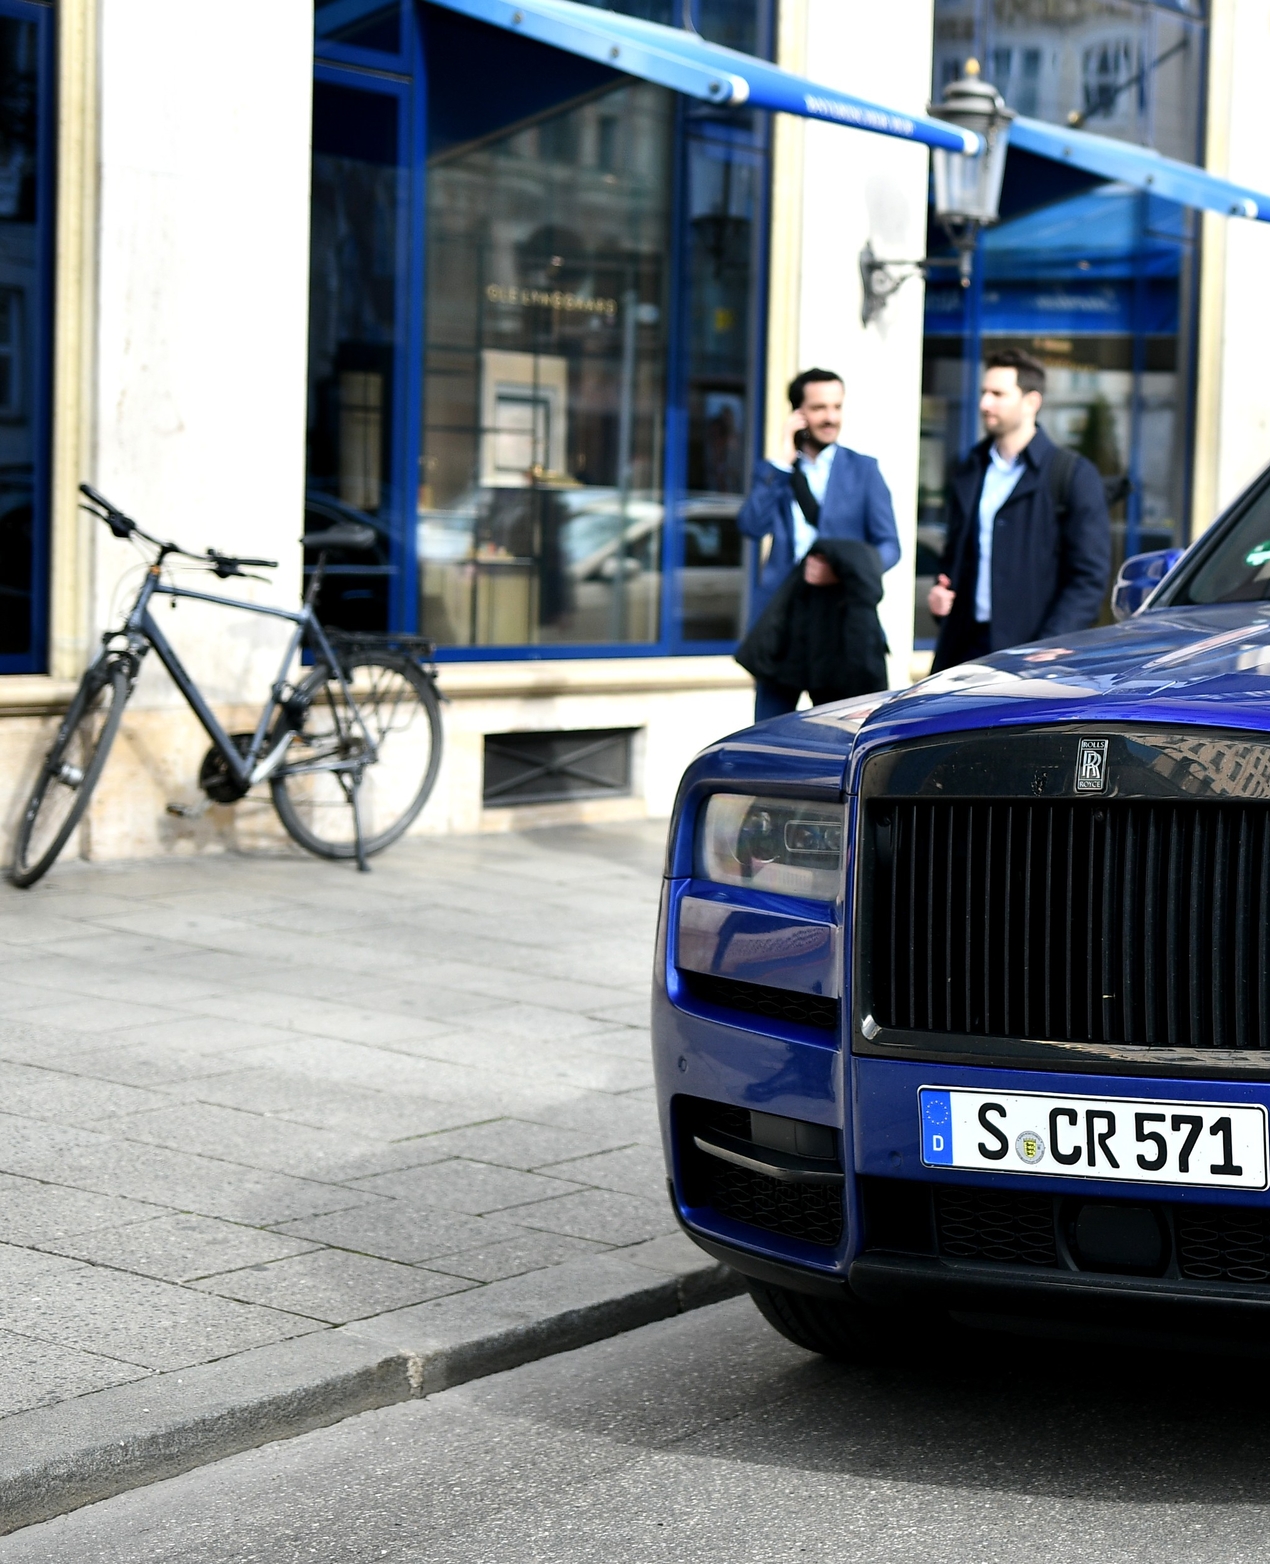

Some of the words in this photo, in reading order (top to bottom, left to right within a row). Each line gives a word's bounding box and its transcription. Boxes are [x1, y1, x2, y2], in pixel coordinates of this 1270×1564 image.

[1079, 780, 1101, 788] ROYCE
[932, 1134, 944, 1151] D
[977, 1102, 1009, 1160] S
[1049, 1107, 1120, 1169] CR
[1134, 1112, 1243, 1176] 571
